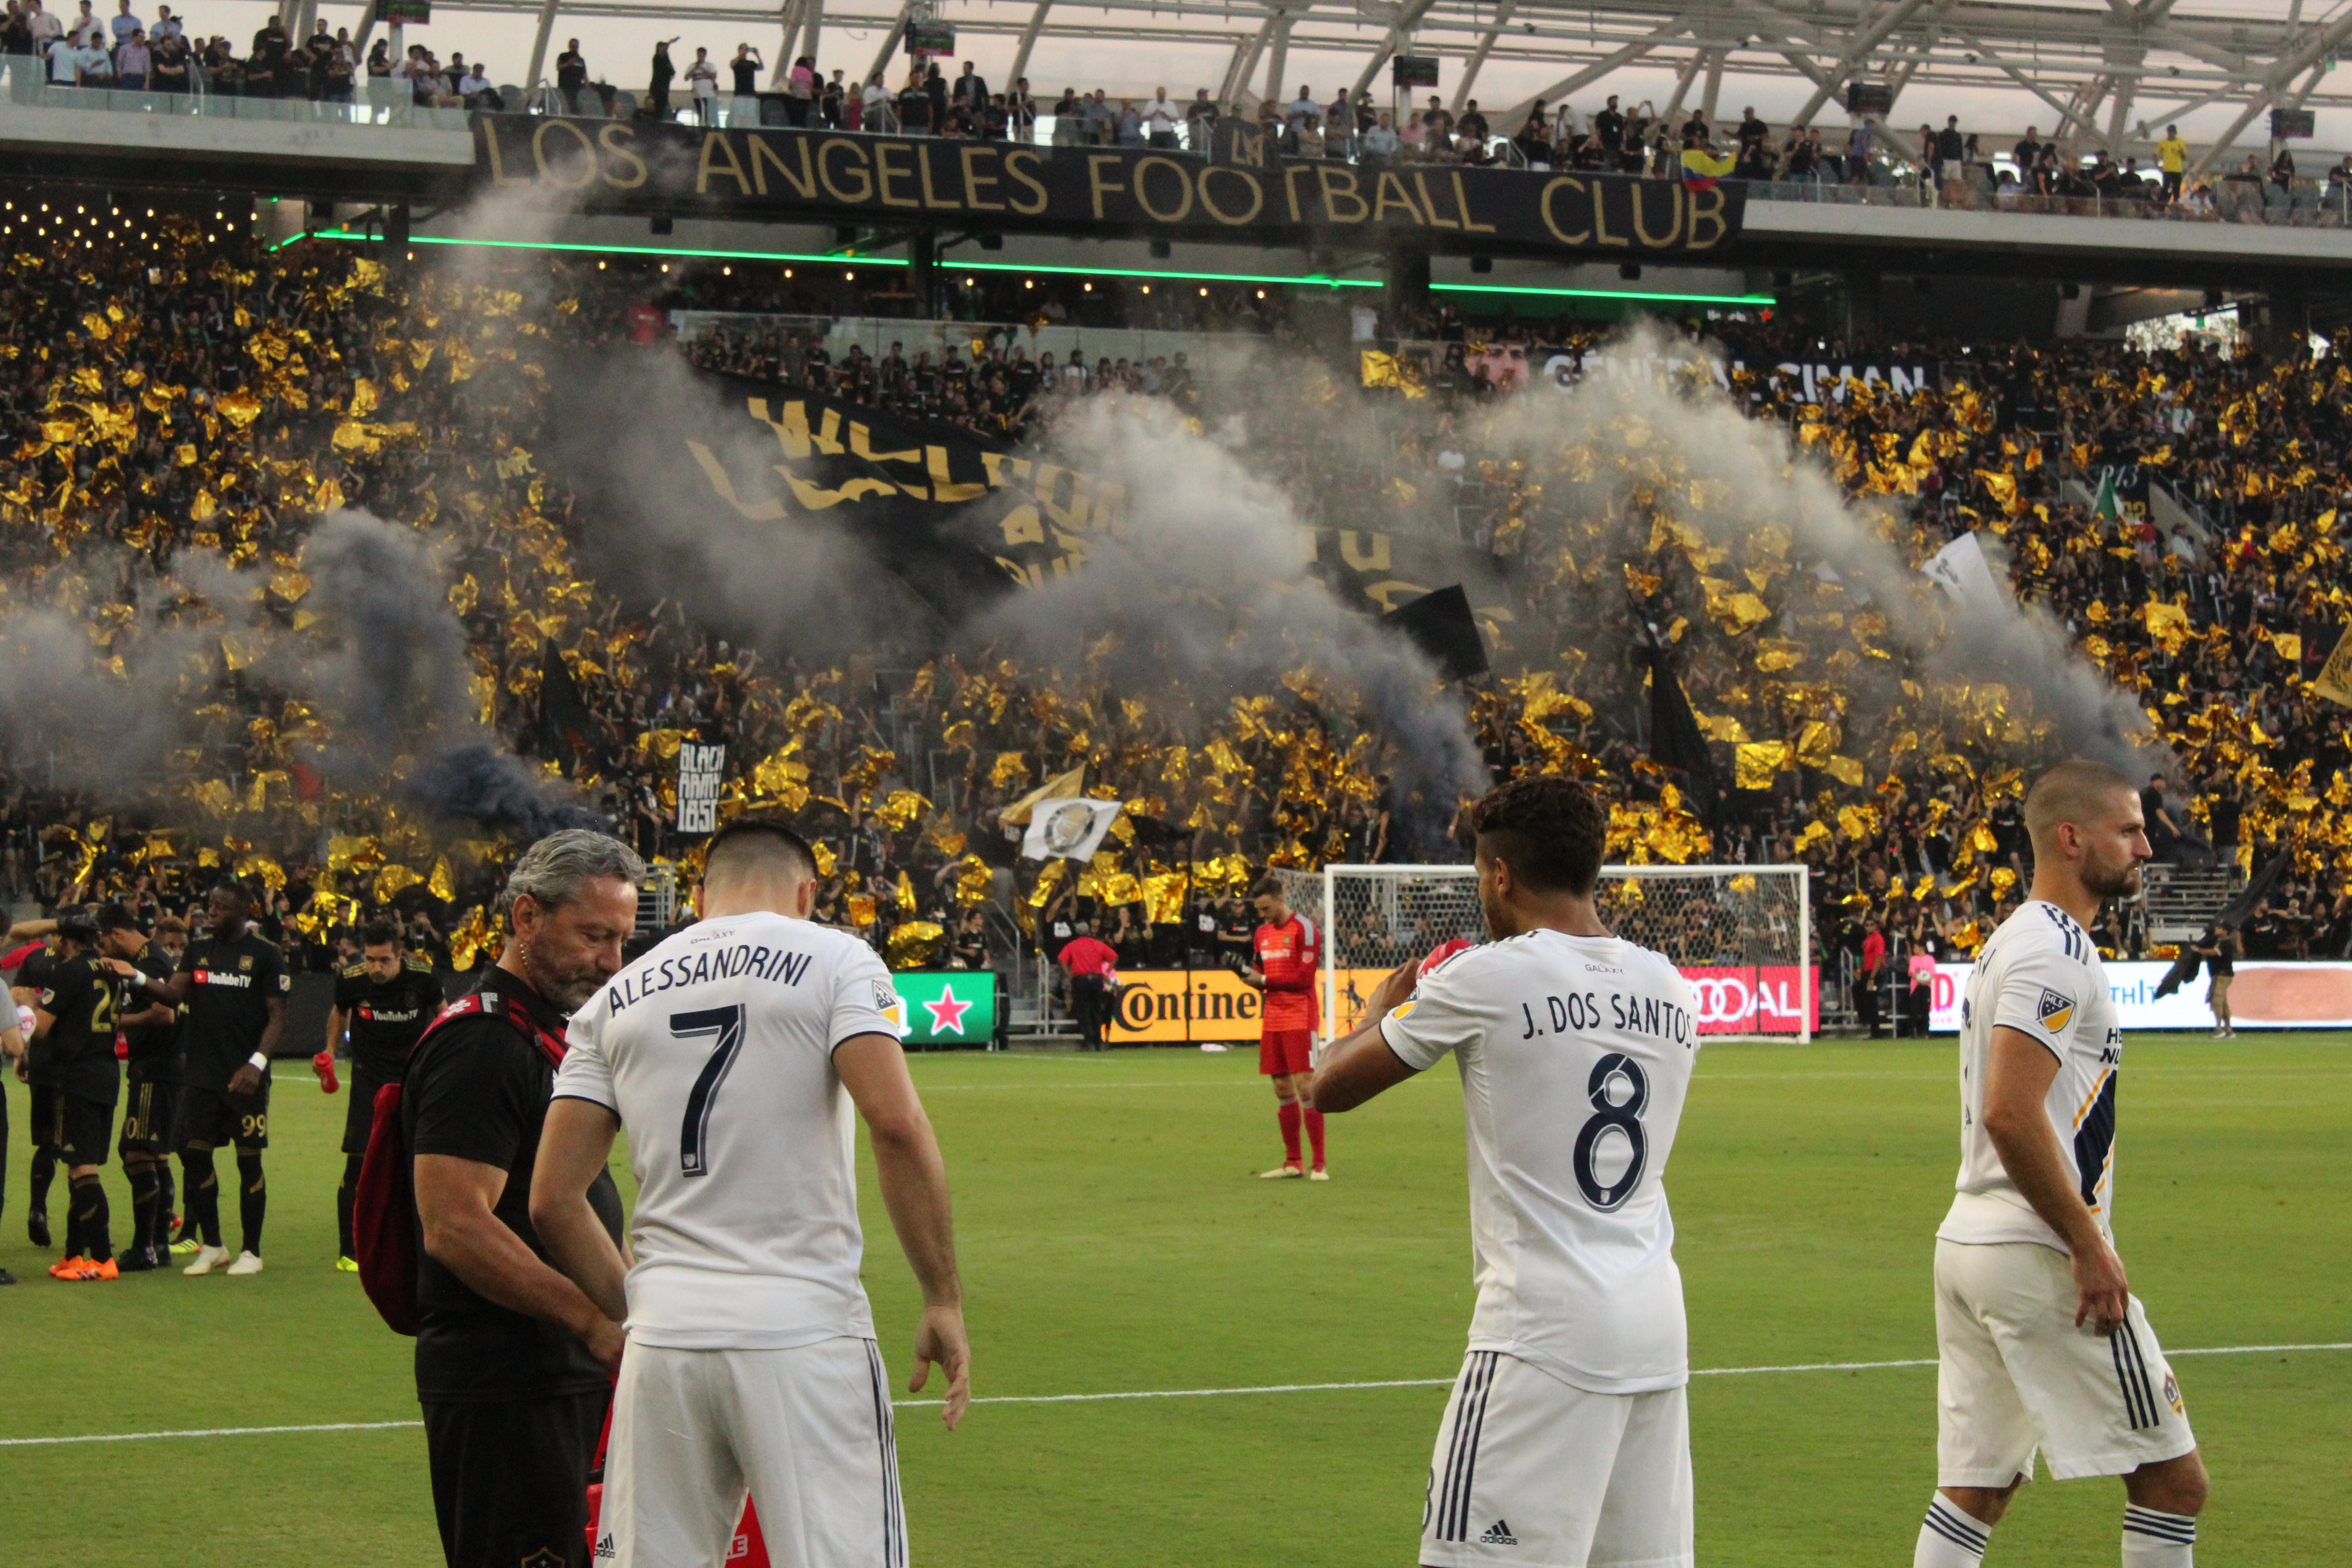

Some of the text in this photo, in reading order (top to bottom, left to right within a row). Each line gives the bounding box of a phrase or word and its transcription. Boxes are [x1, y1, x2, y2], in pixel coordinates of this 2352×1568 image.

[482, 118, 1726, 250] LOS ANGELES FOOTBALL CLUB
[680, 742, 725, 773] BLACK
[679, 772, 721, 799] ARMY
[608, 945, 812, 1018] ALESSANDRINI
[1585, 964, 1626, 975] GALAXY
[2045, 994, 2064, 1008] MLS
[1523, 992, 1692, 1049] J. DOS SANTOS
[670, 1003, 746, 1178] 7
[242, 1114, 267, 1137] 99
[1573, 1052, 1651, 1214] 8
[1480, 1534, 1518, 1545] adidas
